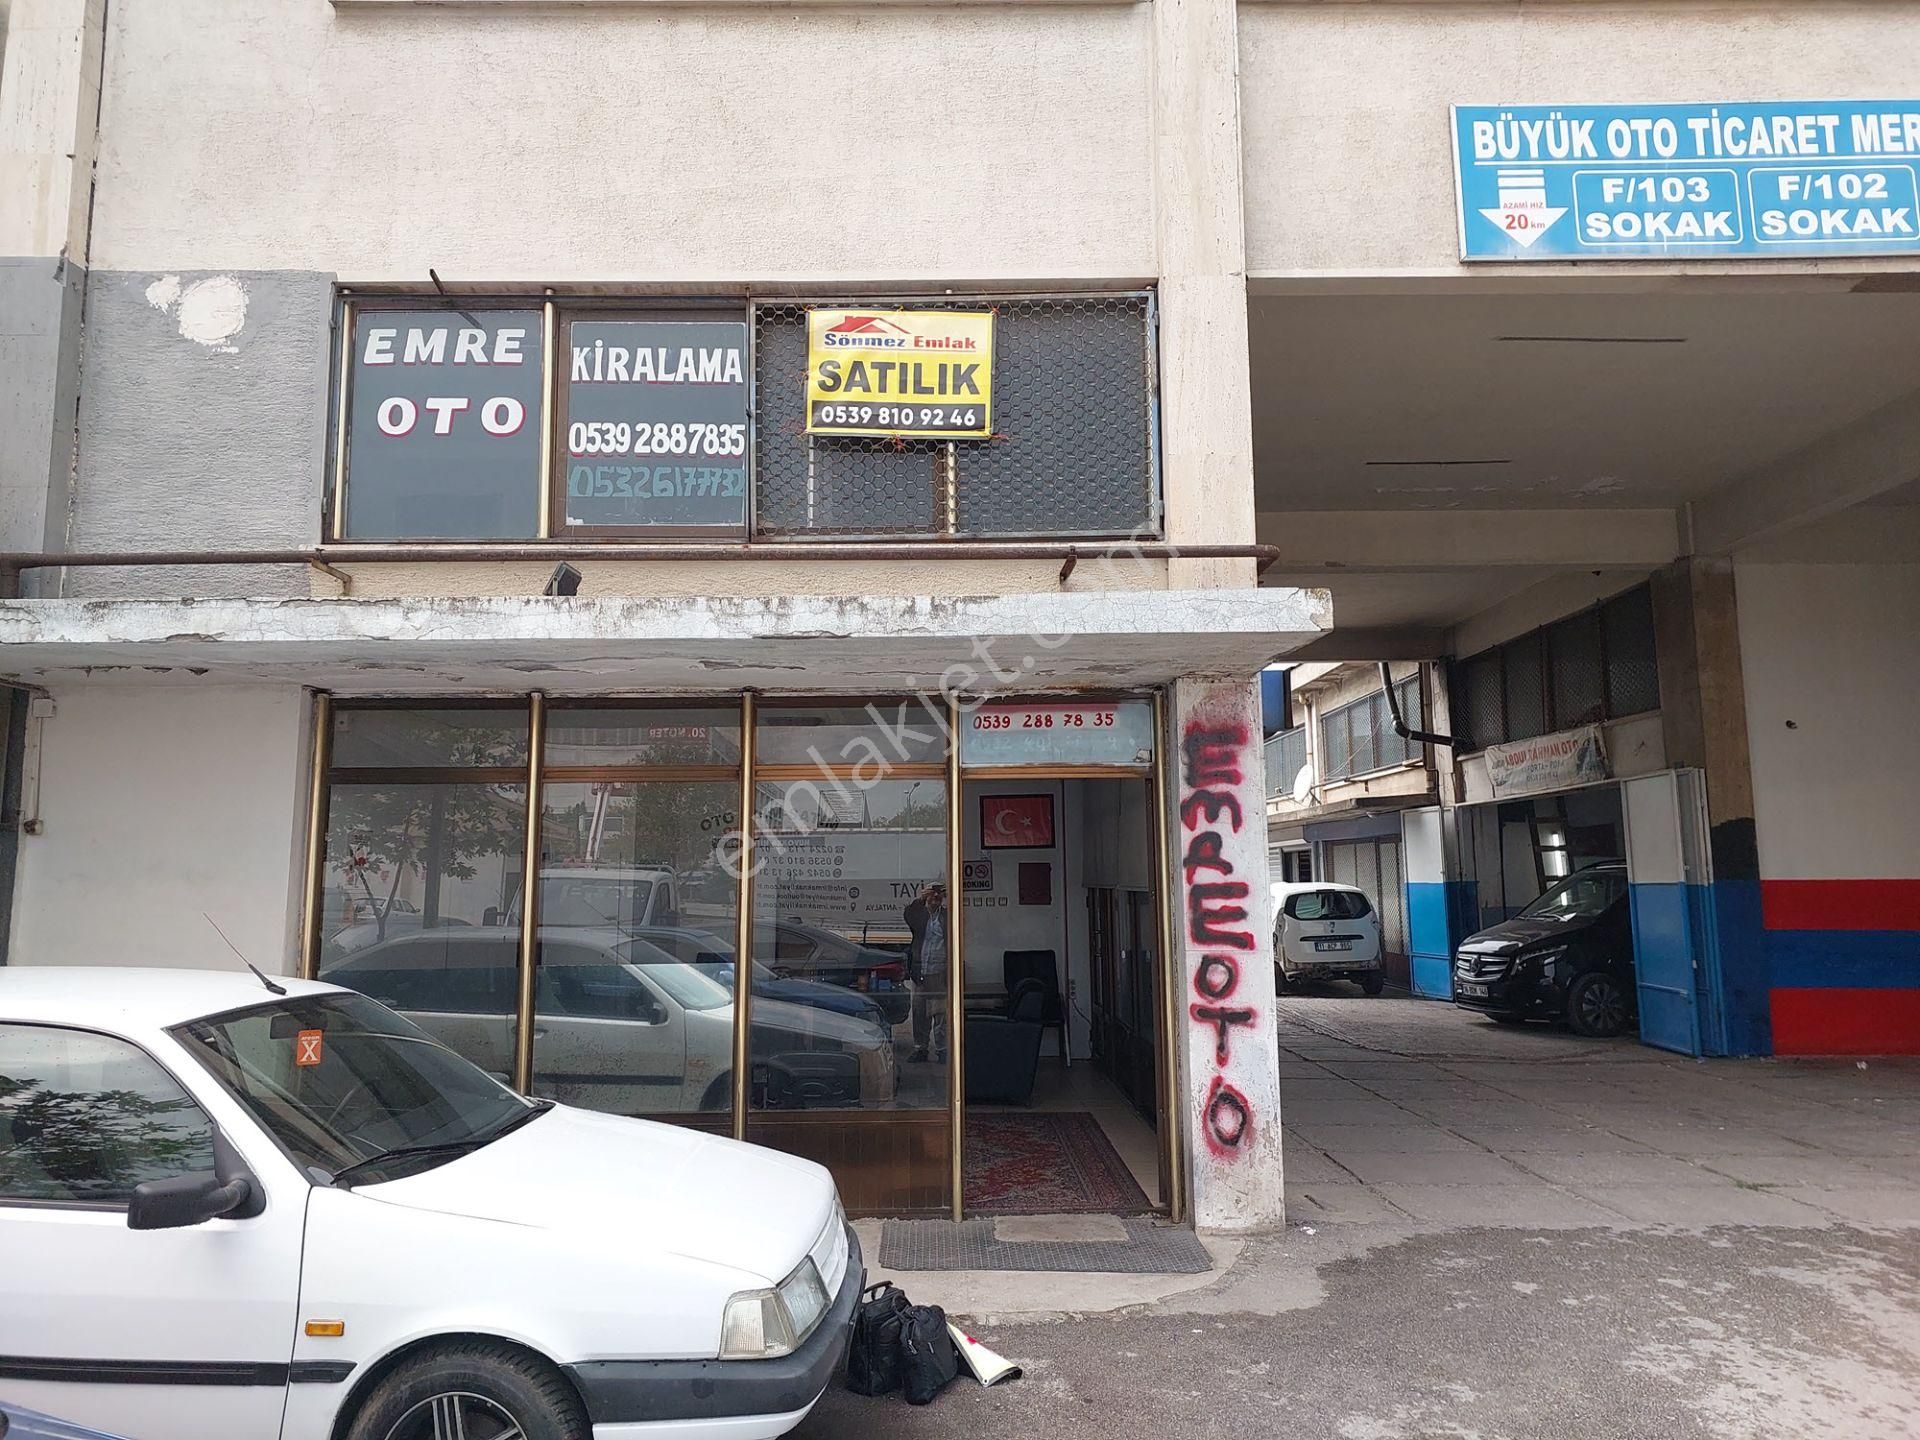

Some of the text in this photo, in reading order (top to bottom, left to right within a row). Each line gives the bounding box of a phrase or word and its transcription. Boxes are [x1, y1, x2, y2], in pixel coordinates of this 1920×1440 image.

[1474, 112, 1598, 160] BÜYÜK
[1606, 118, 1678, 158] OTO
[1688, 109, 1839, 157] TİCARET
[1602, 177, 1710, 203] F/103
[1778, 174, 1888, 200] F/102
[1530, 201, 1544, 209] HIZ
[1505, 214, 1546, 230] 20 km
[1586, 211, 1735, 238] SOKAK
[1761, 208, 1914, 236] SOKAK
[363, 328, 526, 366] EMRE
[824, 333, 976, 349] Sönmez Emlak
[571, 339, 743, 384] KİRALAMA
[818, 360, 980, 395] SATILIK
[377, 397, 526, 437] OTO
[821, 406, 976, 426] 0539 810 92 46
[569, 422, 745, 457] 0539 2887835
[973, 713, 1114, 729] 0539 288 78 35
